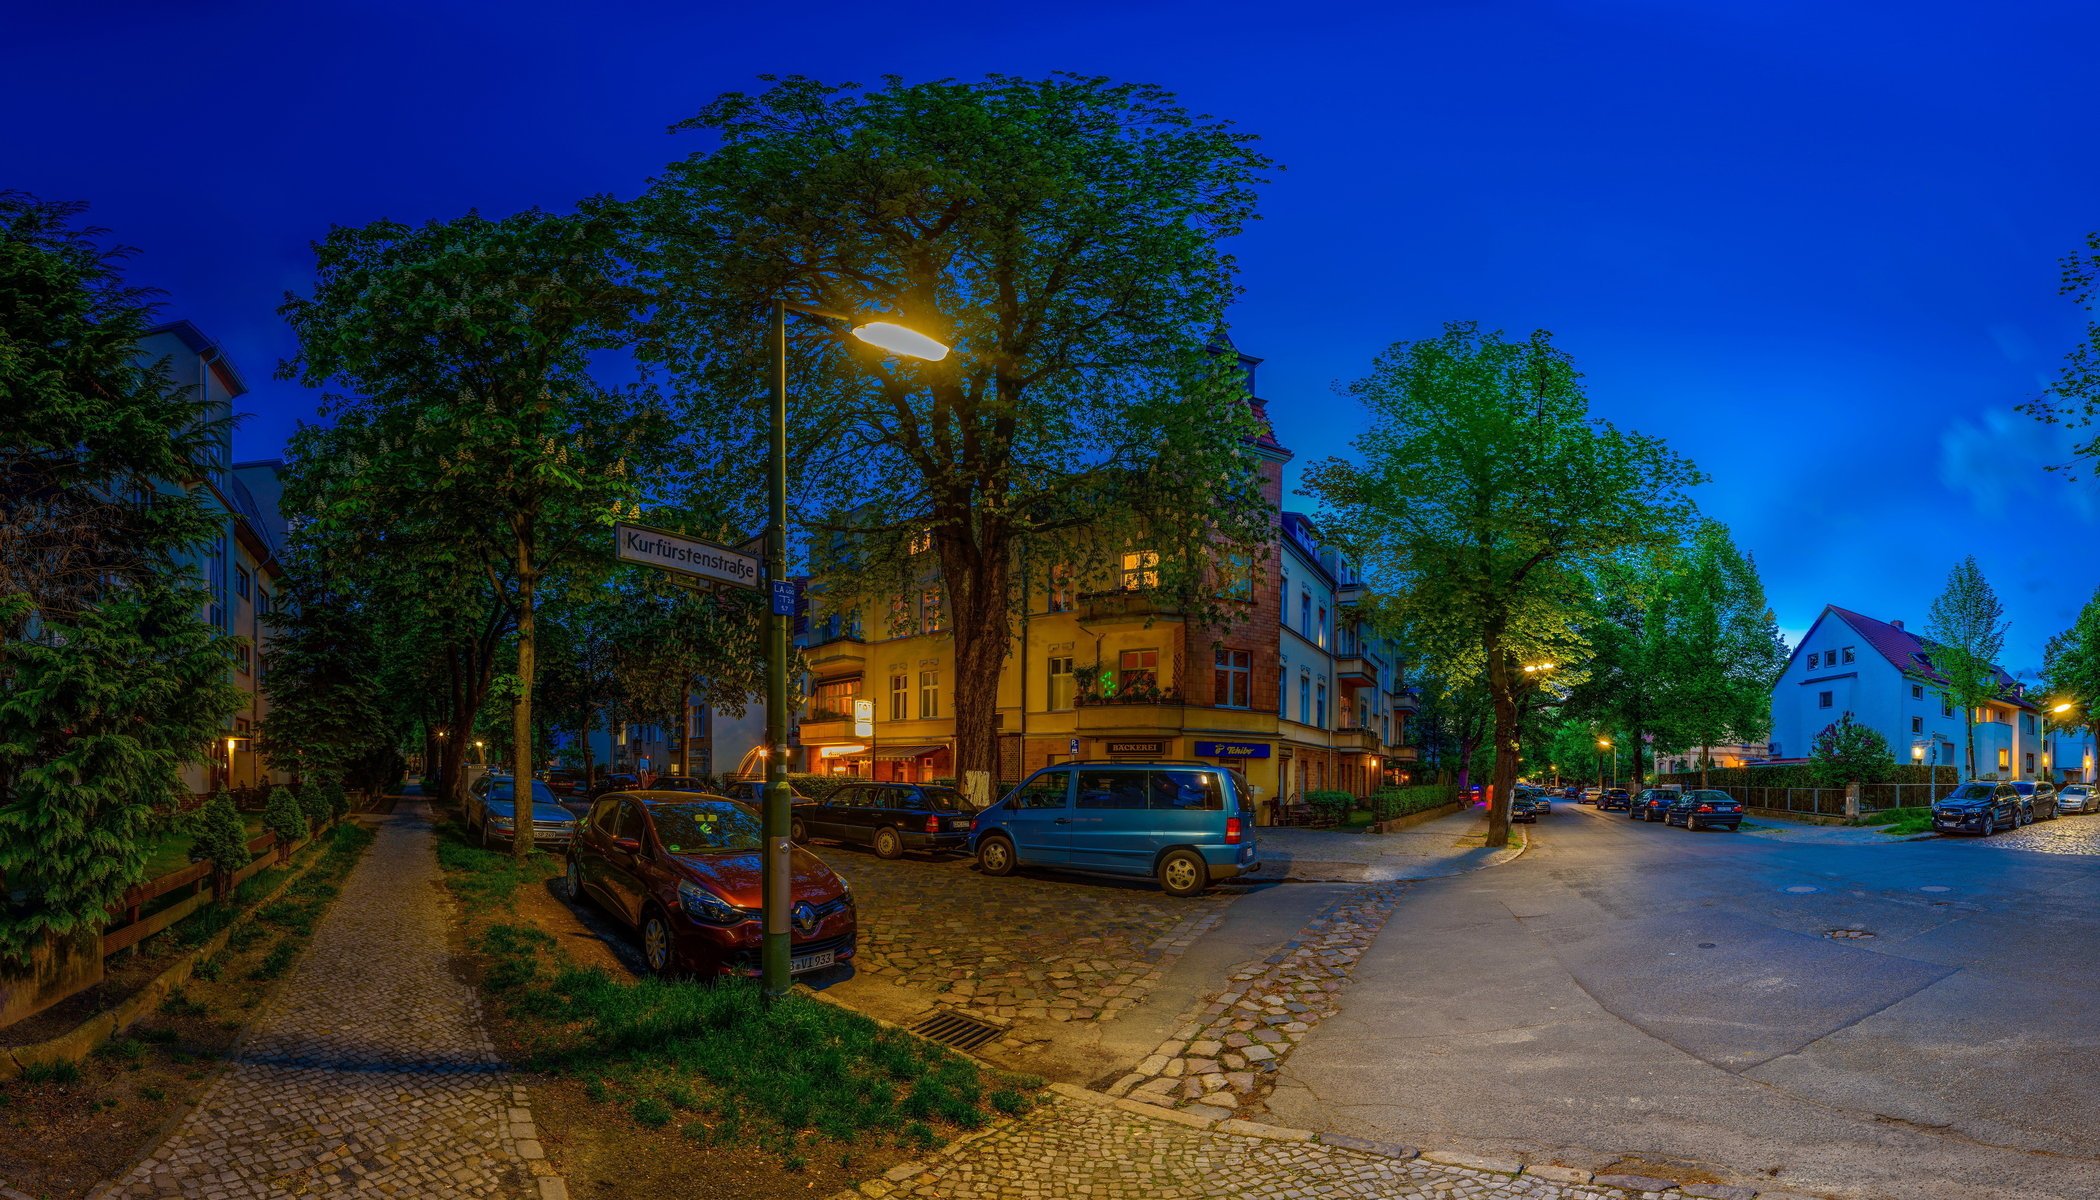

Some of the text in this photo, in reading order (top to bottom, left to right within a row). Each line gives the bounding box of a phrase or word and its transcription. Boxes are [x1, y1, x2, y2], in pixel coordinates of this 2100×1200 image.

[627, 532, 754, 579] Kurfürstenstraße
[1112, 743, 1157, 752] BÄCKEREI
[1226, 746, 1255, 755] Tchibo
[815, 953, 831, 966] 933
